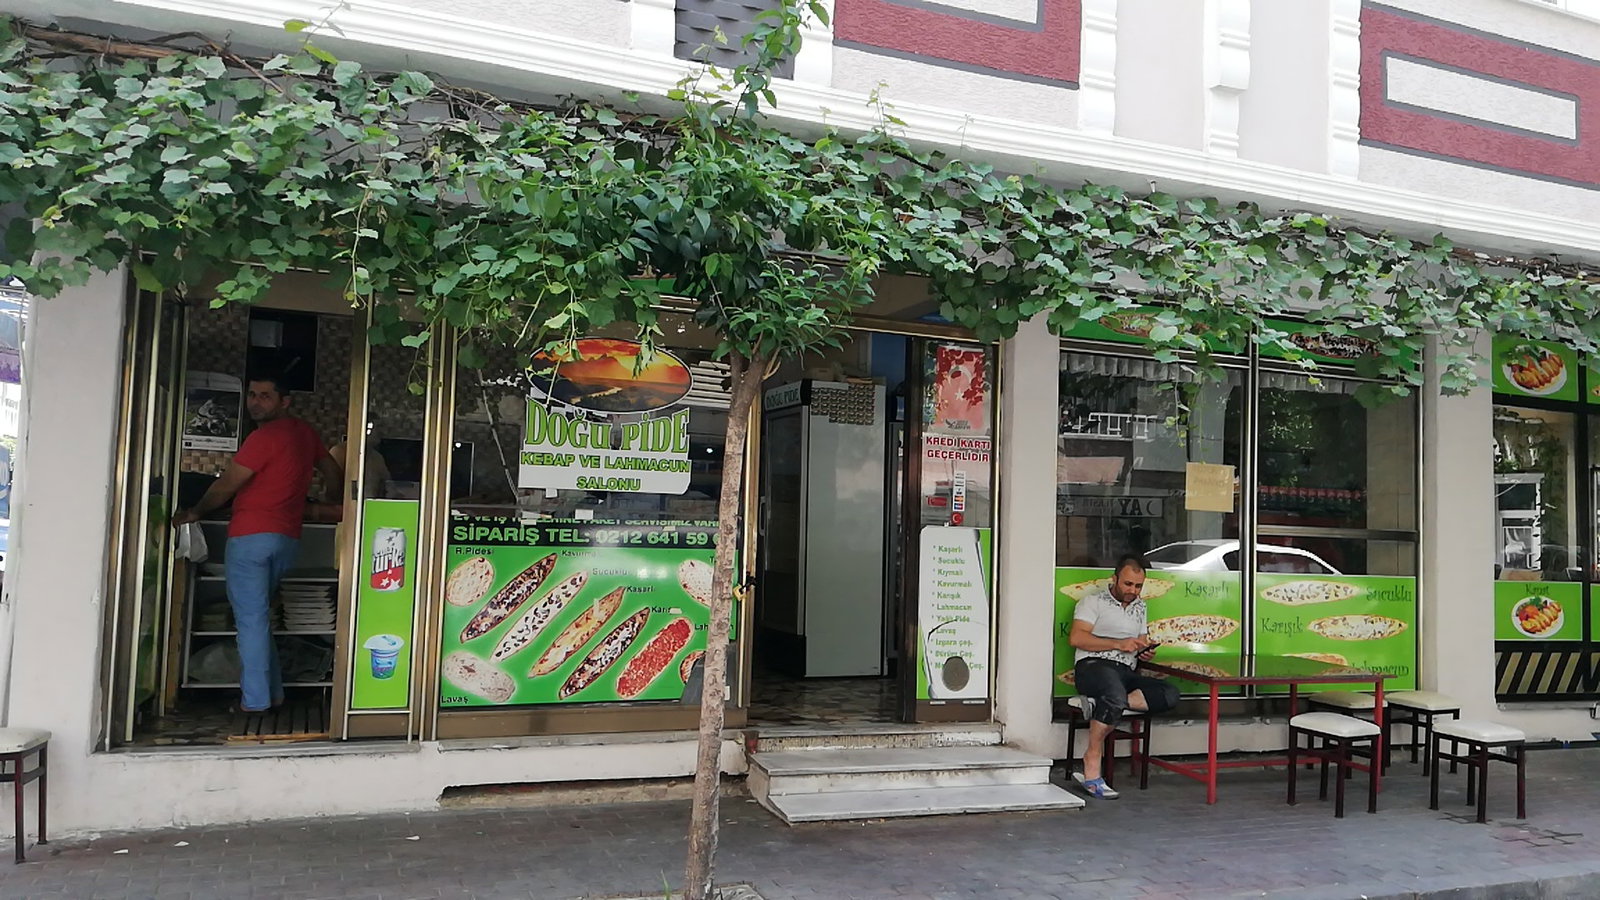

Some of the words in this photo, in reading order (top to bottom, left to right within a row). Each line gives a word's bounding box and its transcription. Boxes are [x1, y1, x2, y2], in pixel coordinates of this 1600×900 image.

[525, 399, 612, 449] DOĞU
[621, 410, 688, 454] PİDE
[521, 452, 575, 466] KEBAP
[579, 455, 600, 468] VE
[604, 456, 690, 473] LAHMACUN
[576, 476, 641, 490] SALONU
[453, 523, 540, 546] SİPARİŞ
[545, 528, 590, 543] TEL:
[595, 530, 642, 544] 0212
[647, 531, 678, 545] 641
[686, 532, 708, 546] 59
[1366, 585, 1412, 602] Sucuklu
[1261, 617, 1304, 638] Karışık
[441, 695, 469, 704] Lavaş
